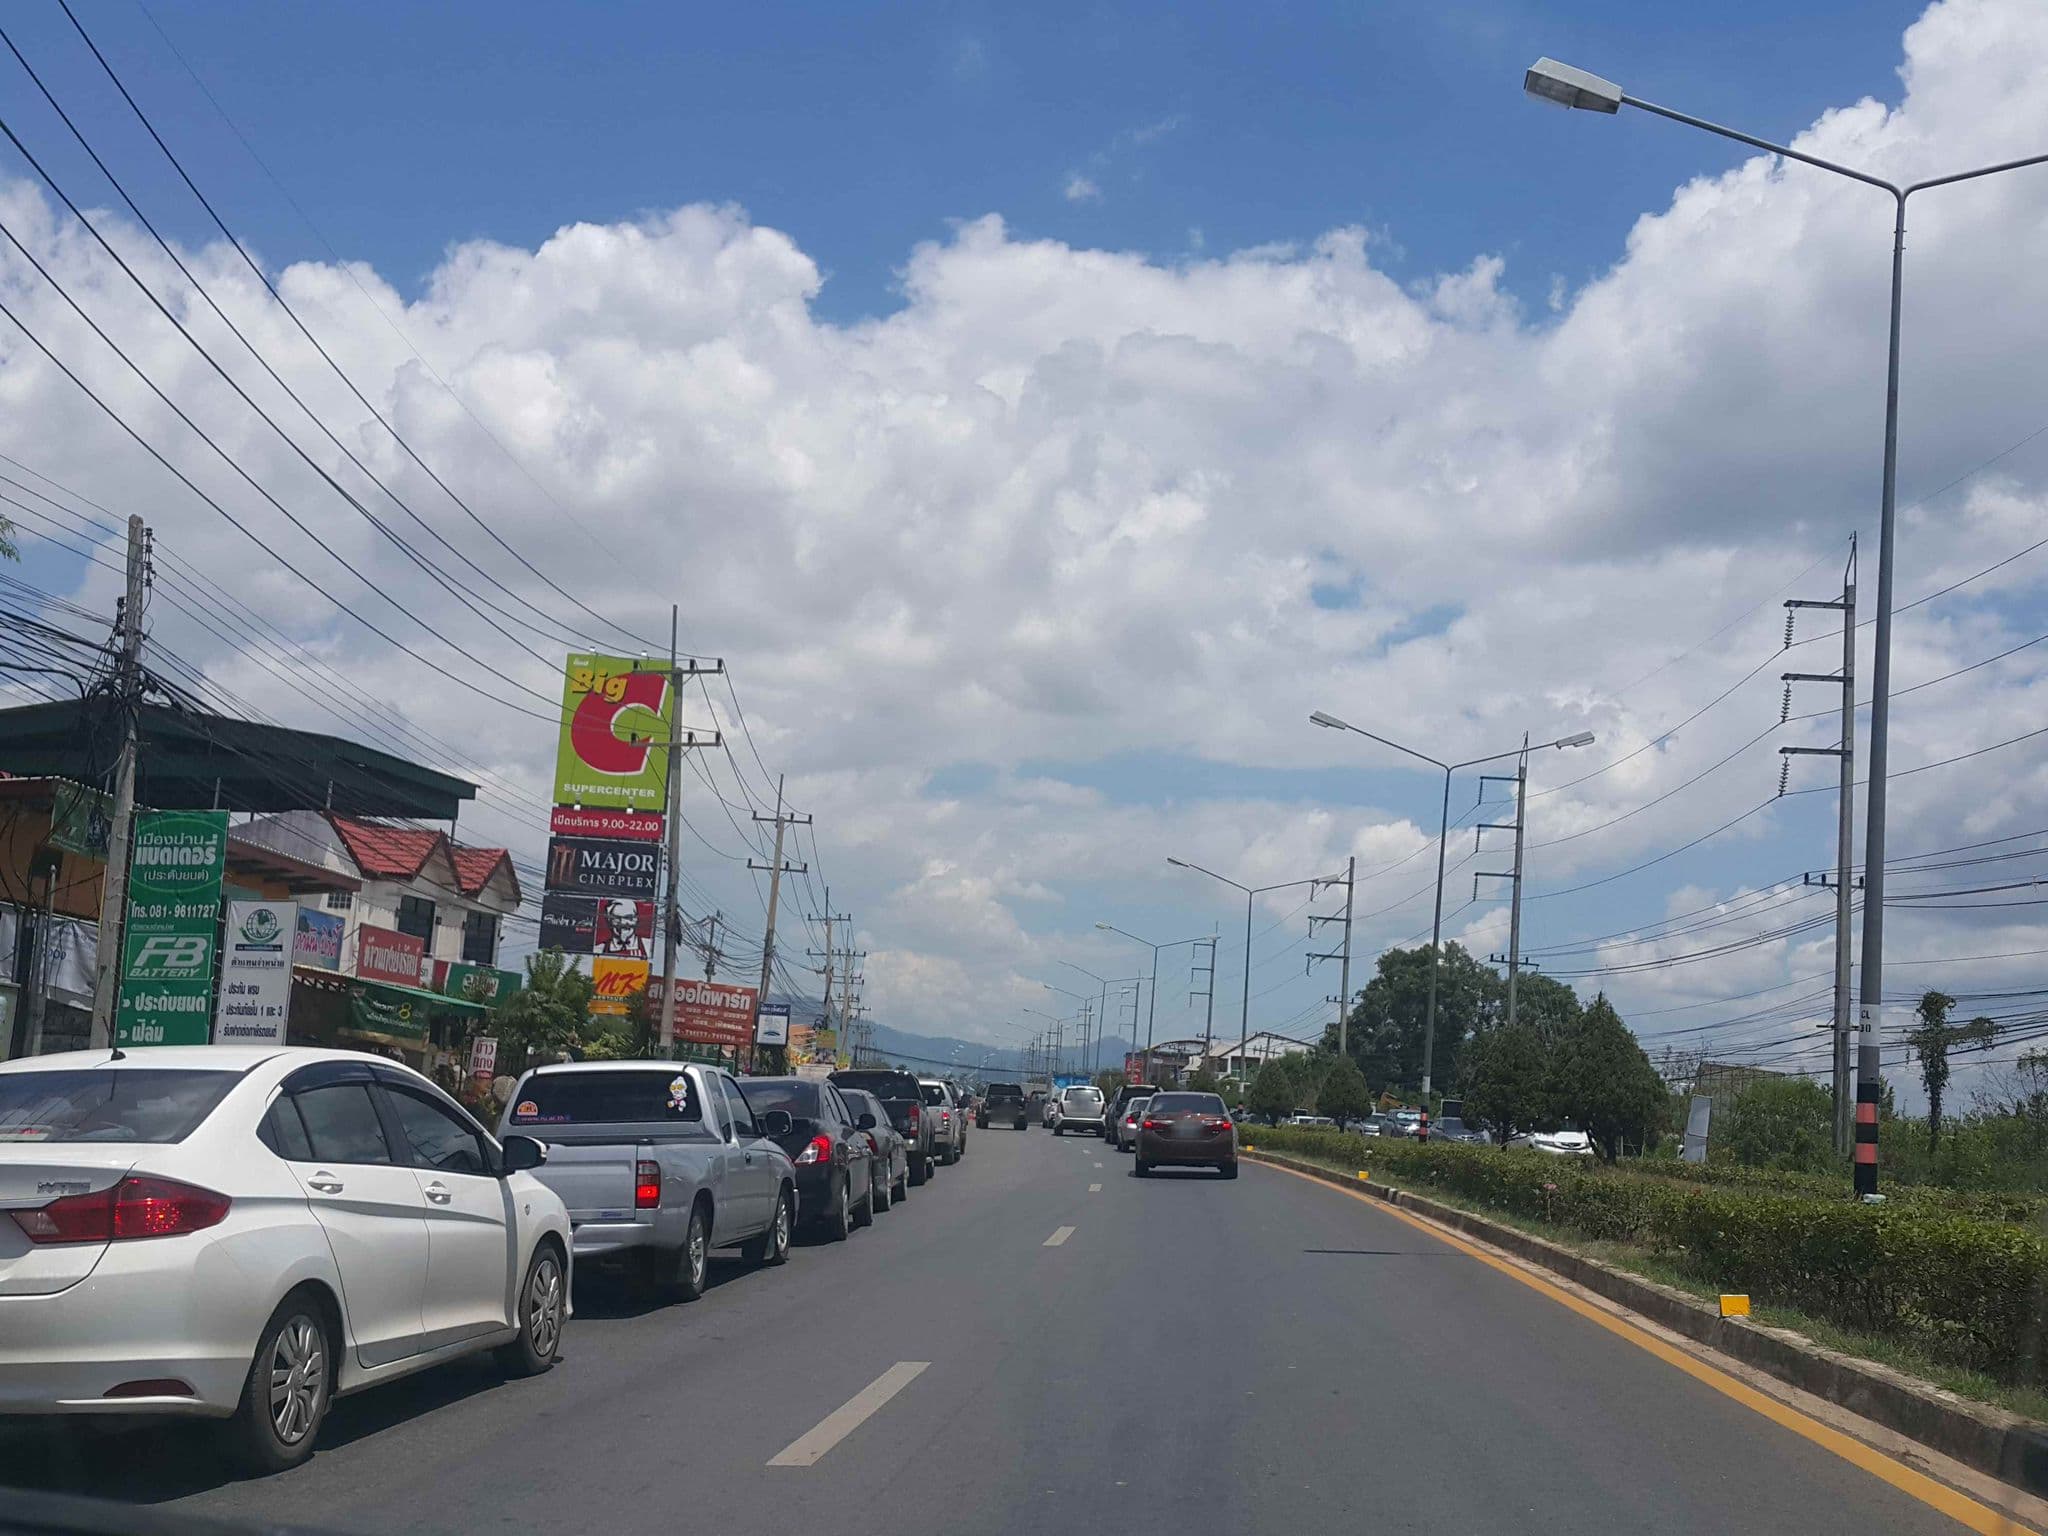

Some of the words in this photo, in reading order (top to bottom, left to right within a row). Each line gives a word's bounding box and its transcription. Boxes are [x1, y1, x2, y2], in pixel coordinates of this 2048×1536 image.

[572, 668, 628, 703] Big
[571, 672, 668, 774] C
[564, 784, 655, 799] SUPERCENTER
[554, 814, 599, 828] เปิดบริการ
[602, 818, 659, 832] 9.00-22.00
[581, 850, 655, 874] MAJOR
[578, 874, 654, 888] CINEPLEX
[174, 903, 215, 917] 9611727
[134, 937, 208, 968] FB
[129, 968, 200, 978] BATTERY
[596, 971, 644, 995] MK
[134, 988, 208, 1012] ประดับยนต์
[278, 1005, 283, 1017] 3
[131, 1018, 164, 1043] ฟิล์ม
